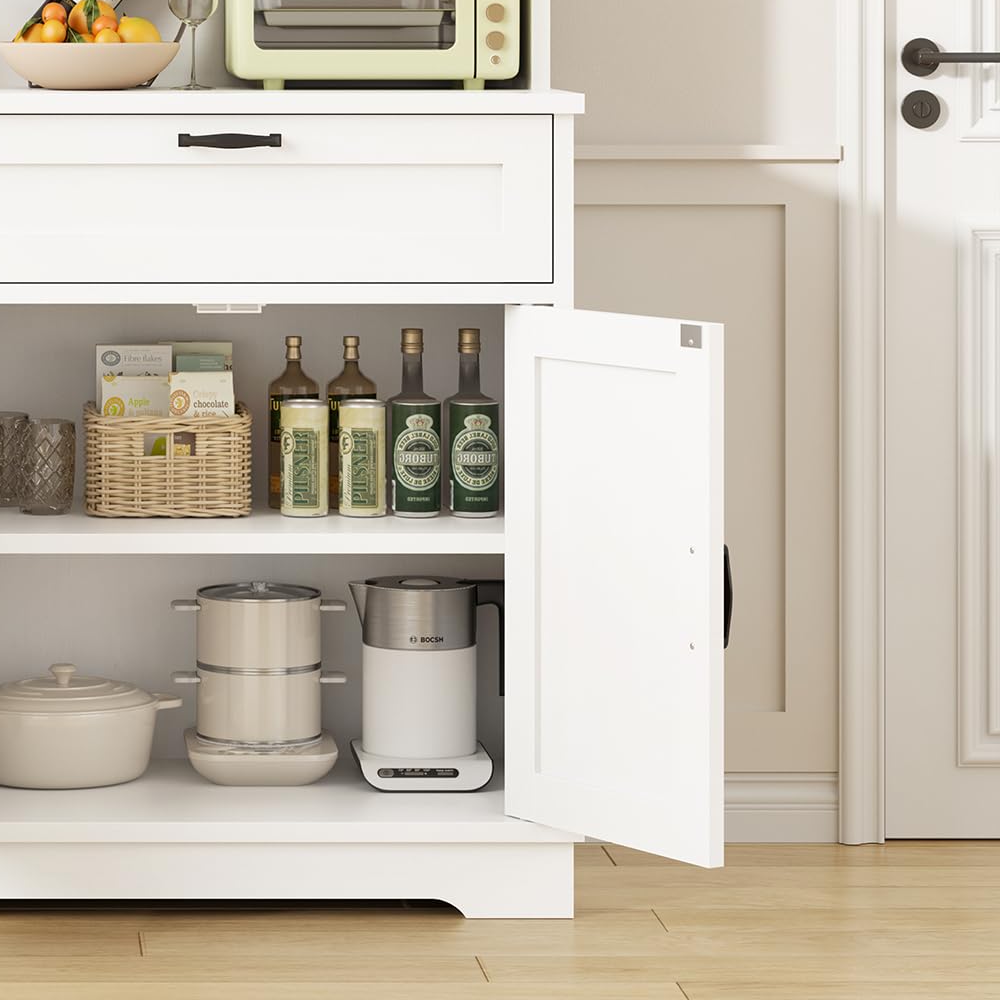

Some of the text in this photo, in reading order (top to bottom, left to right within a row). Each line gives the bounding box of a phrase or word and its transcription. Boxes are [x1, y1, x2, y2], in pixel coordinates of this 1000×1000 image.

[193, 400, 229, 409] chocolate
[294, 431, 310, 504] PILSNER
[352, 431, 369, 504] PILSNER
